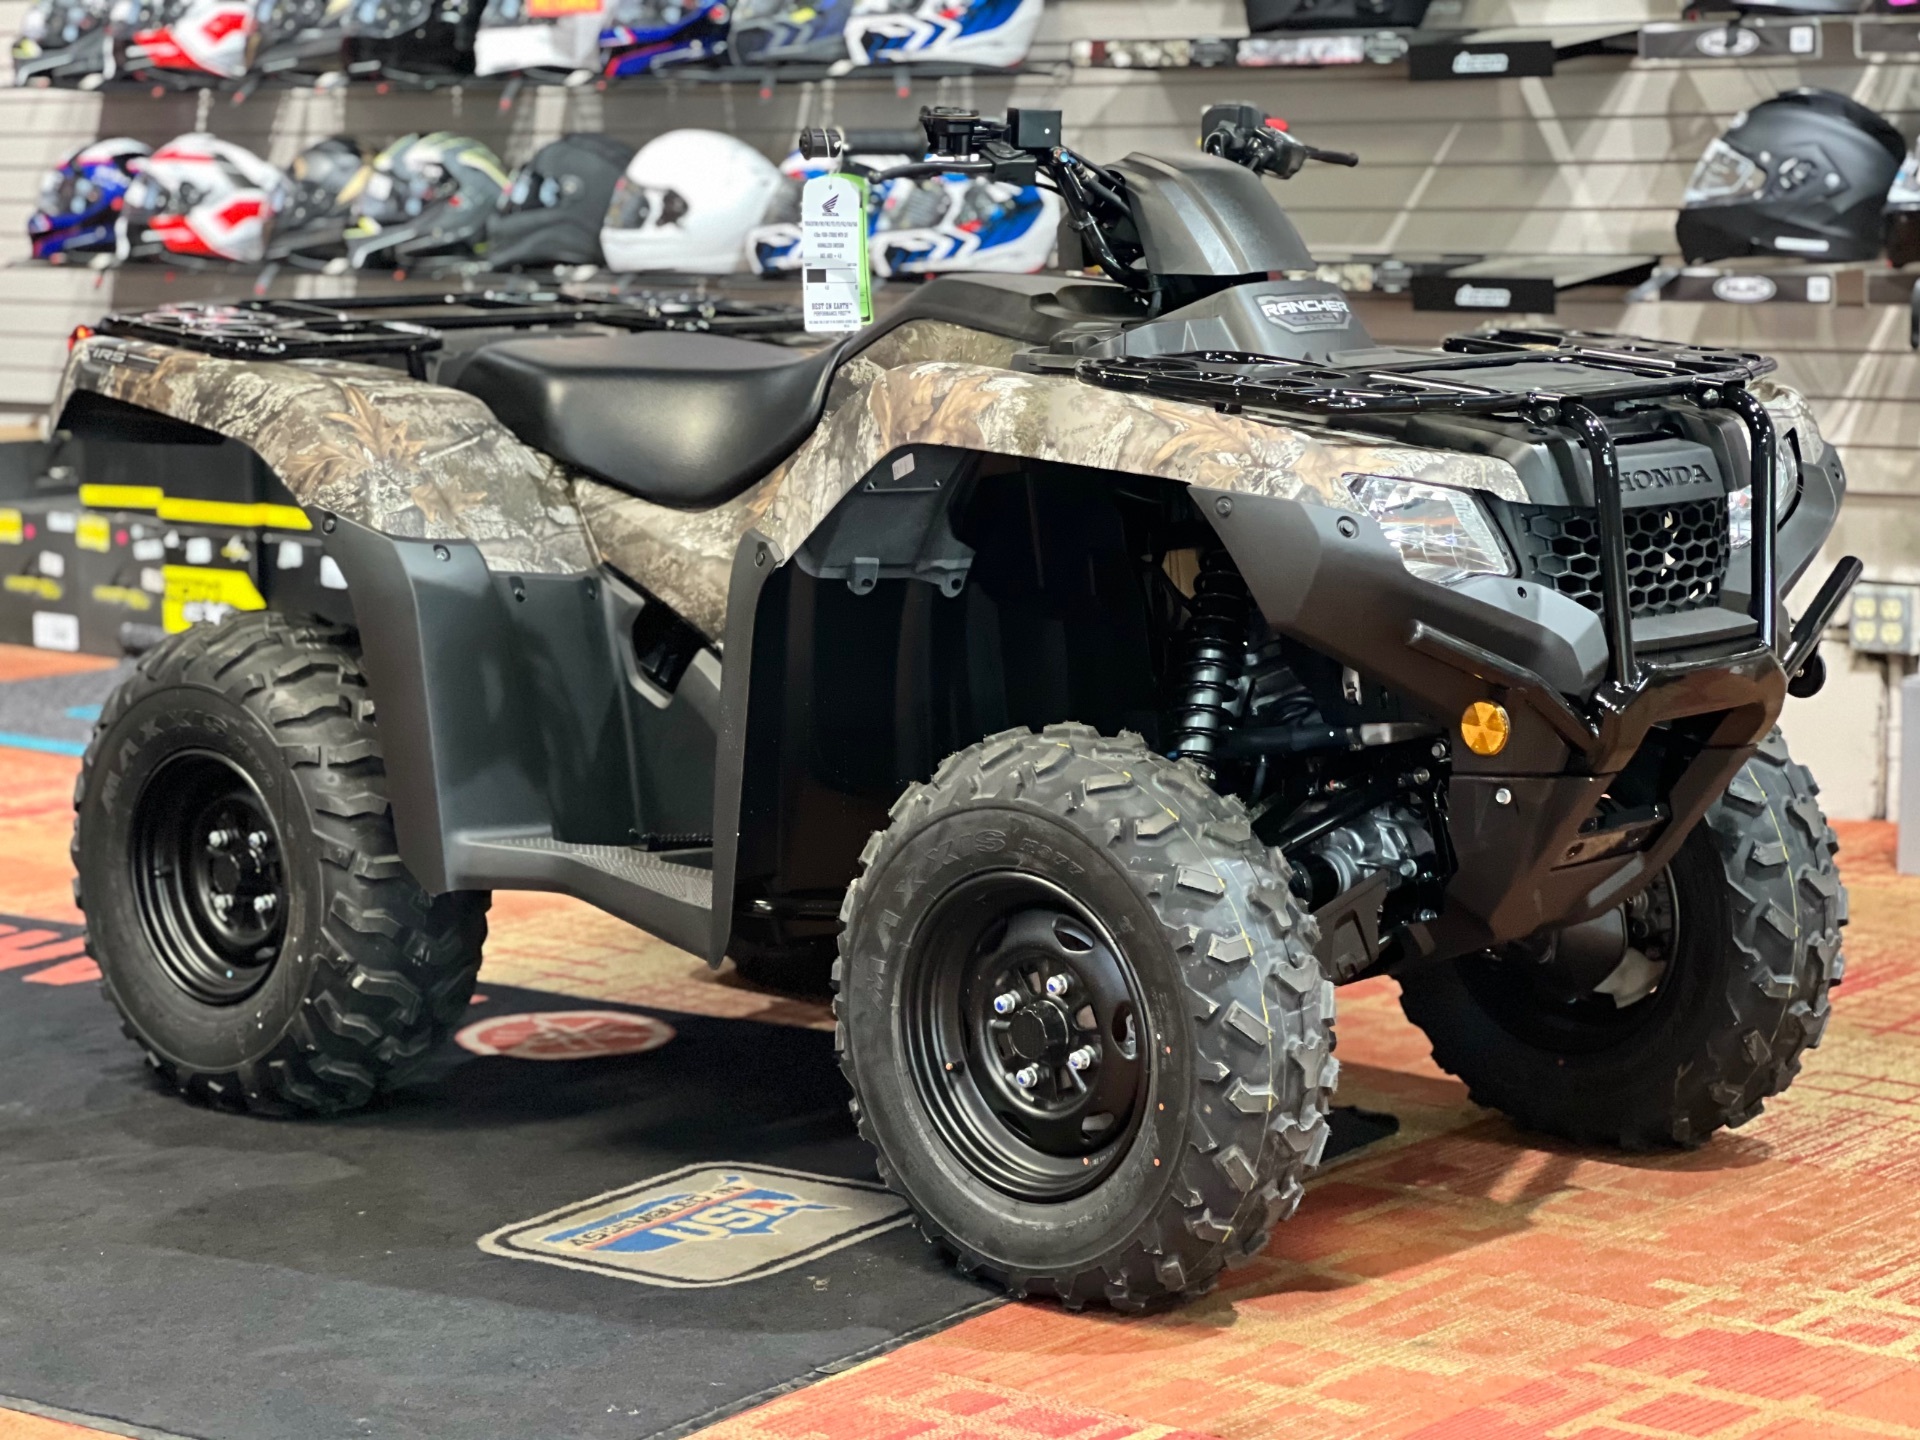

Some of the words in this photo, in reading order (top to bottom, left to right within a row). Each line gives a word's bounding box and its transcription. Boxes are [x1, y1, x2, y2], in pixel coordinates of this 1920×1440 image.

[811, 302, 824, 310] BEST
[825, 302, 832, 310] ON
[1261, 300, 1350, 317] RANCHER
[92, 347, 126, 363] IRS
[1619, 464, 1713, 492] HONDA
[867, 829, 1007, 1012] MAXXIS
[570, 1195, 711, 1247] ASSEMBLED
[713, 1186, 745, 1196] IN
[648, 1198, 801, 1242] USA
